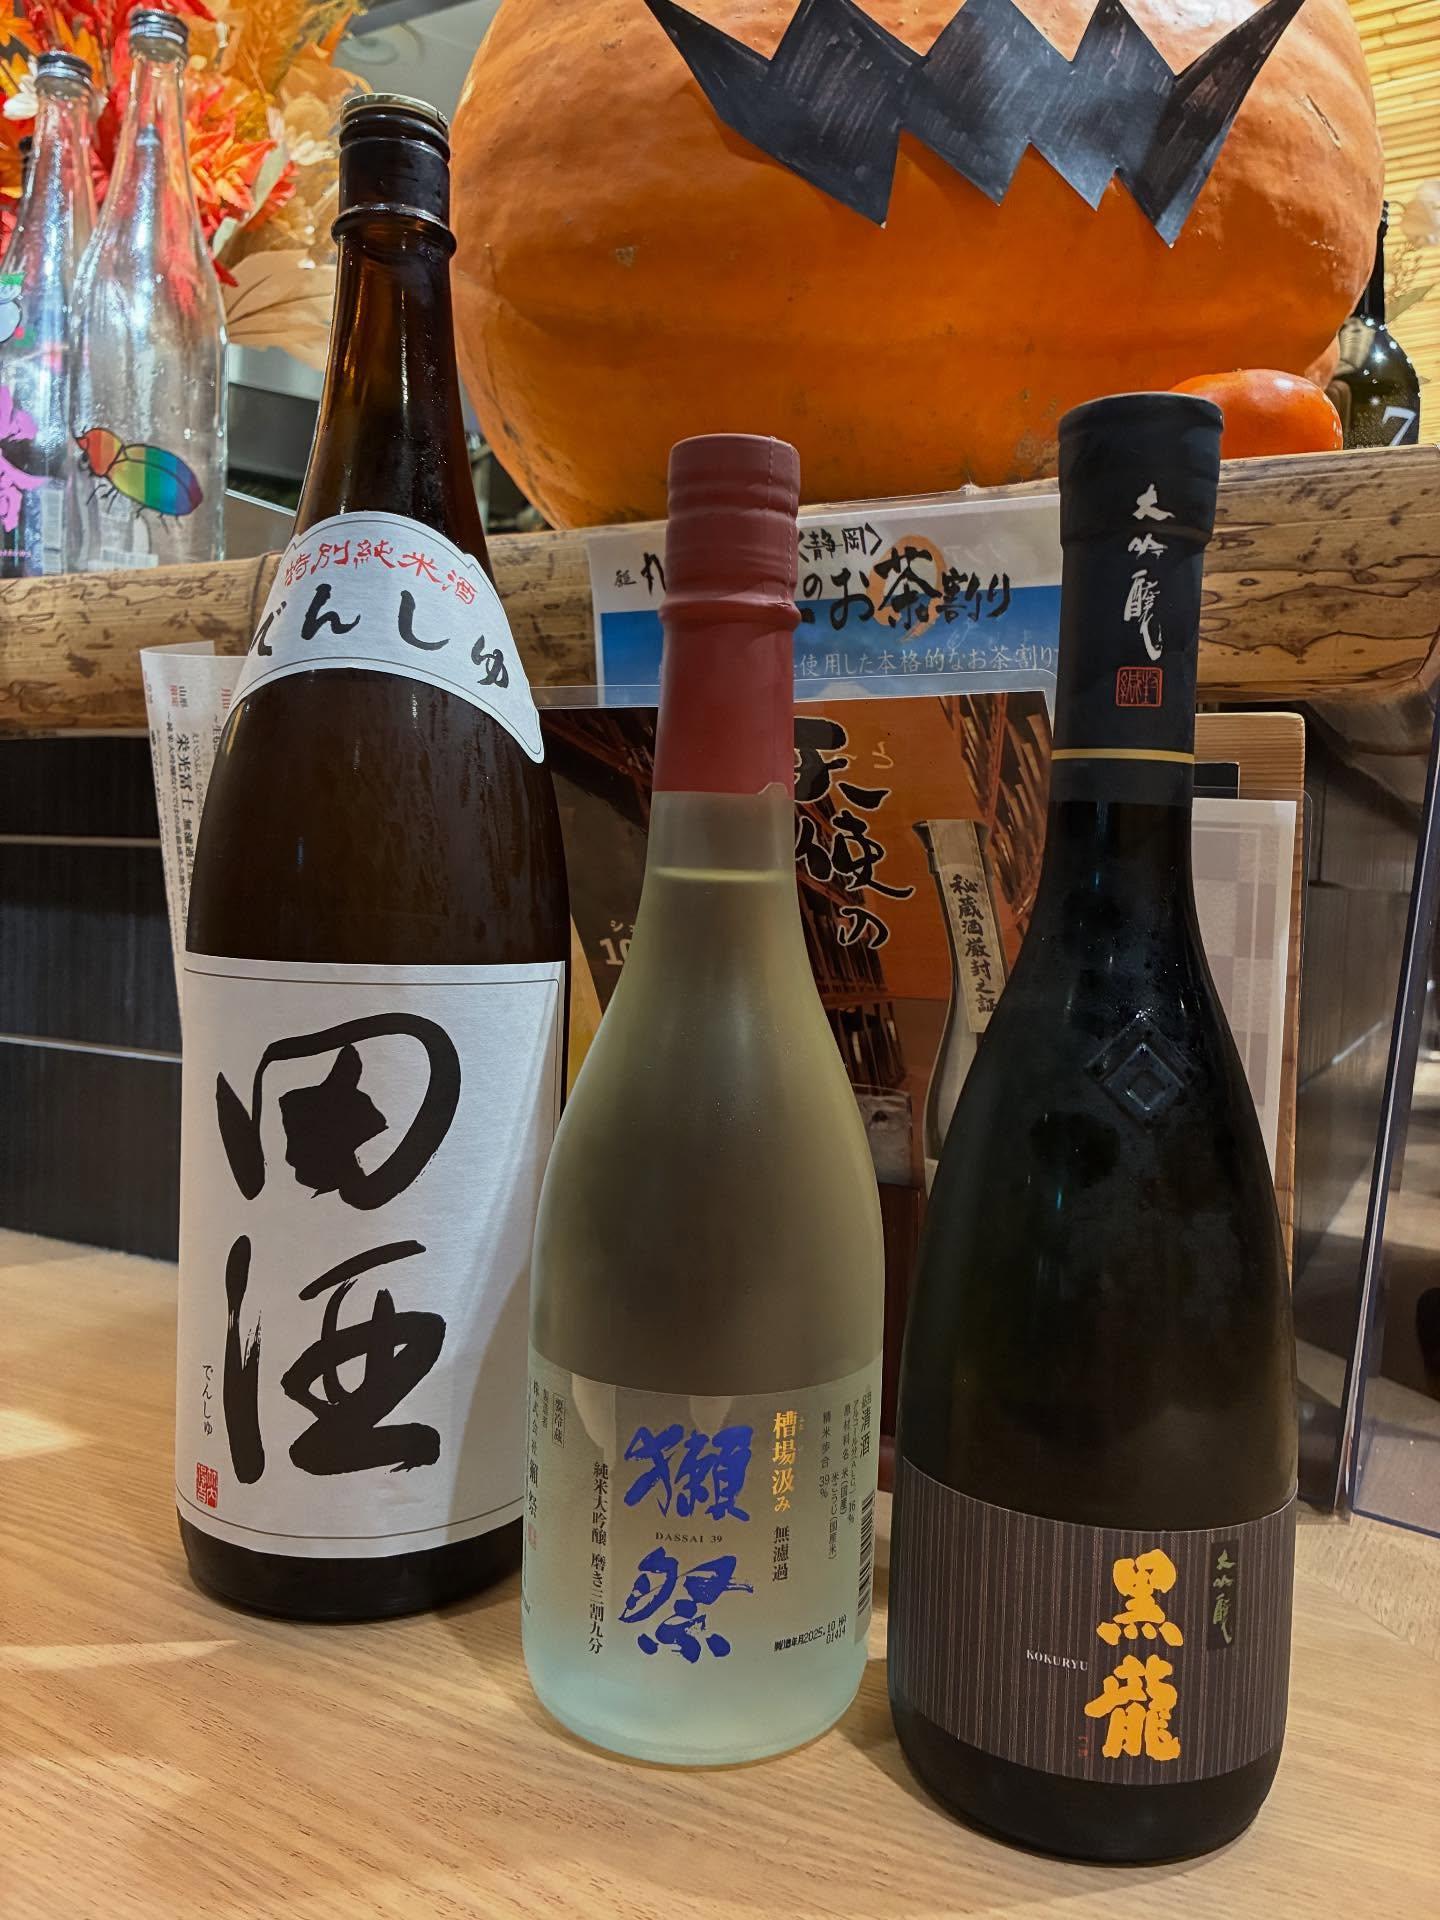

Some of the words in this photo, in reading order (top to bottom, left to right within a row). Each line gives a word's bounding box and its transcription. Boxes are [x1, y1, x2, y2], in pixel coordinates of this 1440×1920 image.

[1382, 406, 1417, 446] 7
[284, 539, 478, 605] 特別純米酒
[793, 646, 1059, 678] 使用した本格的なお茶割り
[216, 1012, 461, 1484] 田酒
[202, 1365, 213, 1436] でんしゅ
[772, 1411, 797, 1512] 槽場汲み
[592, 1461, 609, 1546] 純米大吟醸
[655, 1532, 703, 1543] DASSAI
[711, 1535, 723, 1543] 39
[772, 1525, 789, 1581] 無濾過
[1026, 1649, 1088, 1672] KOKURYU
